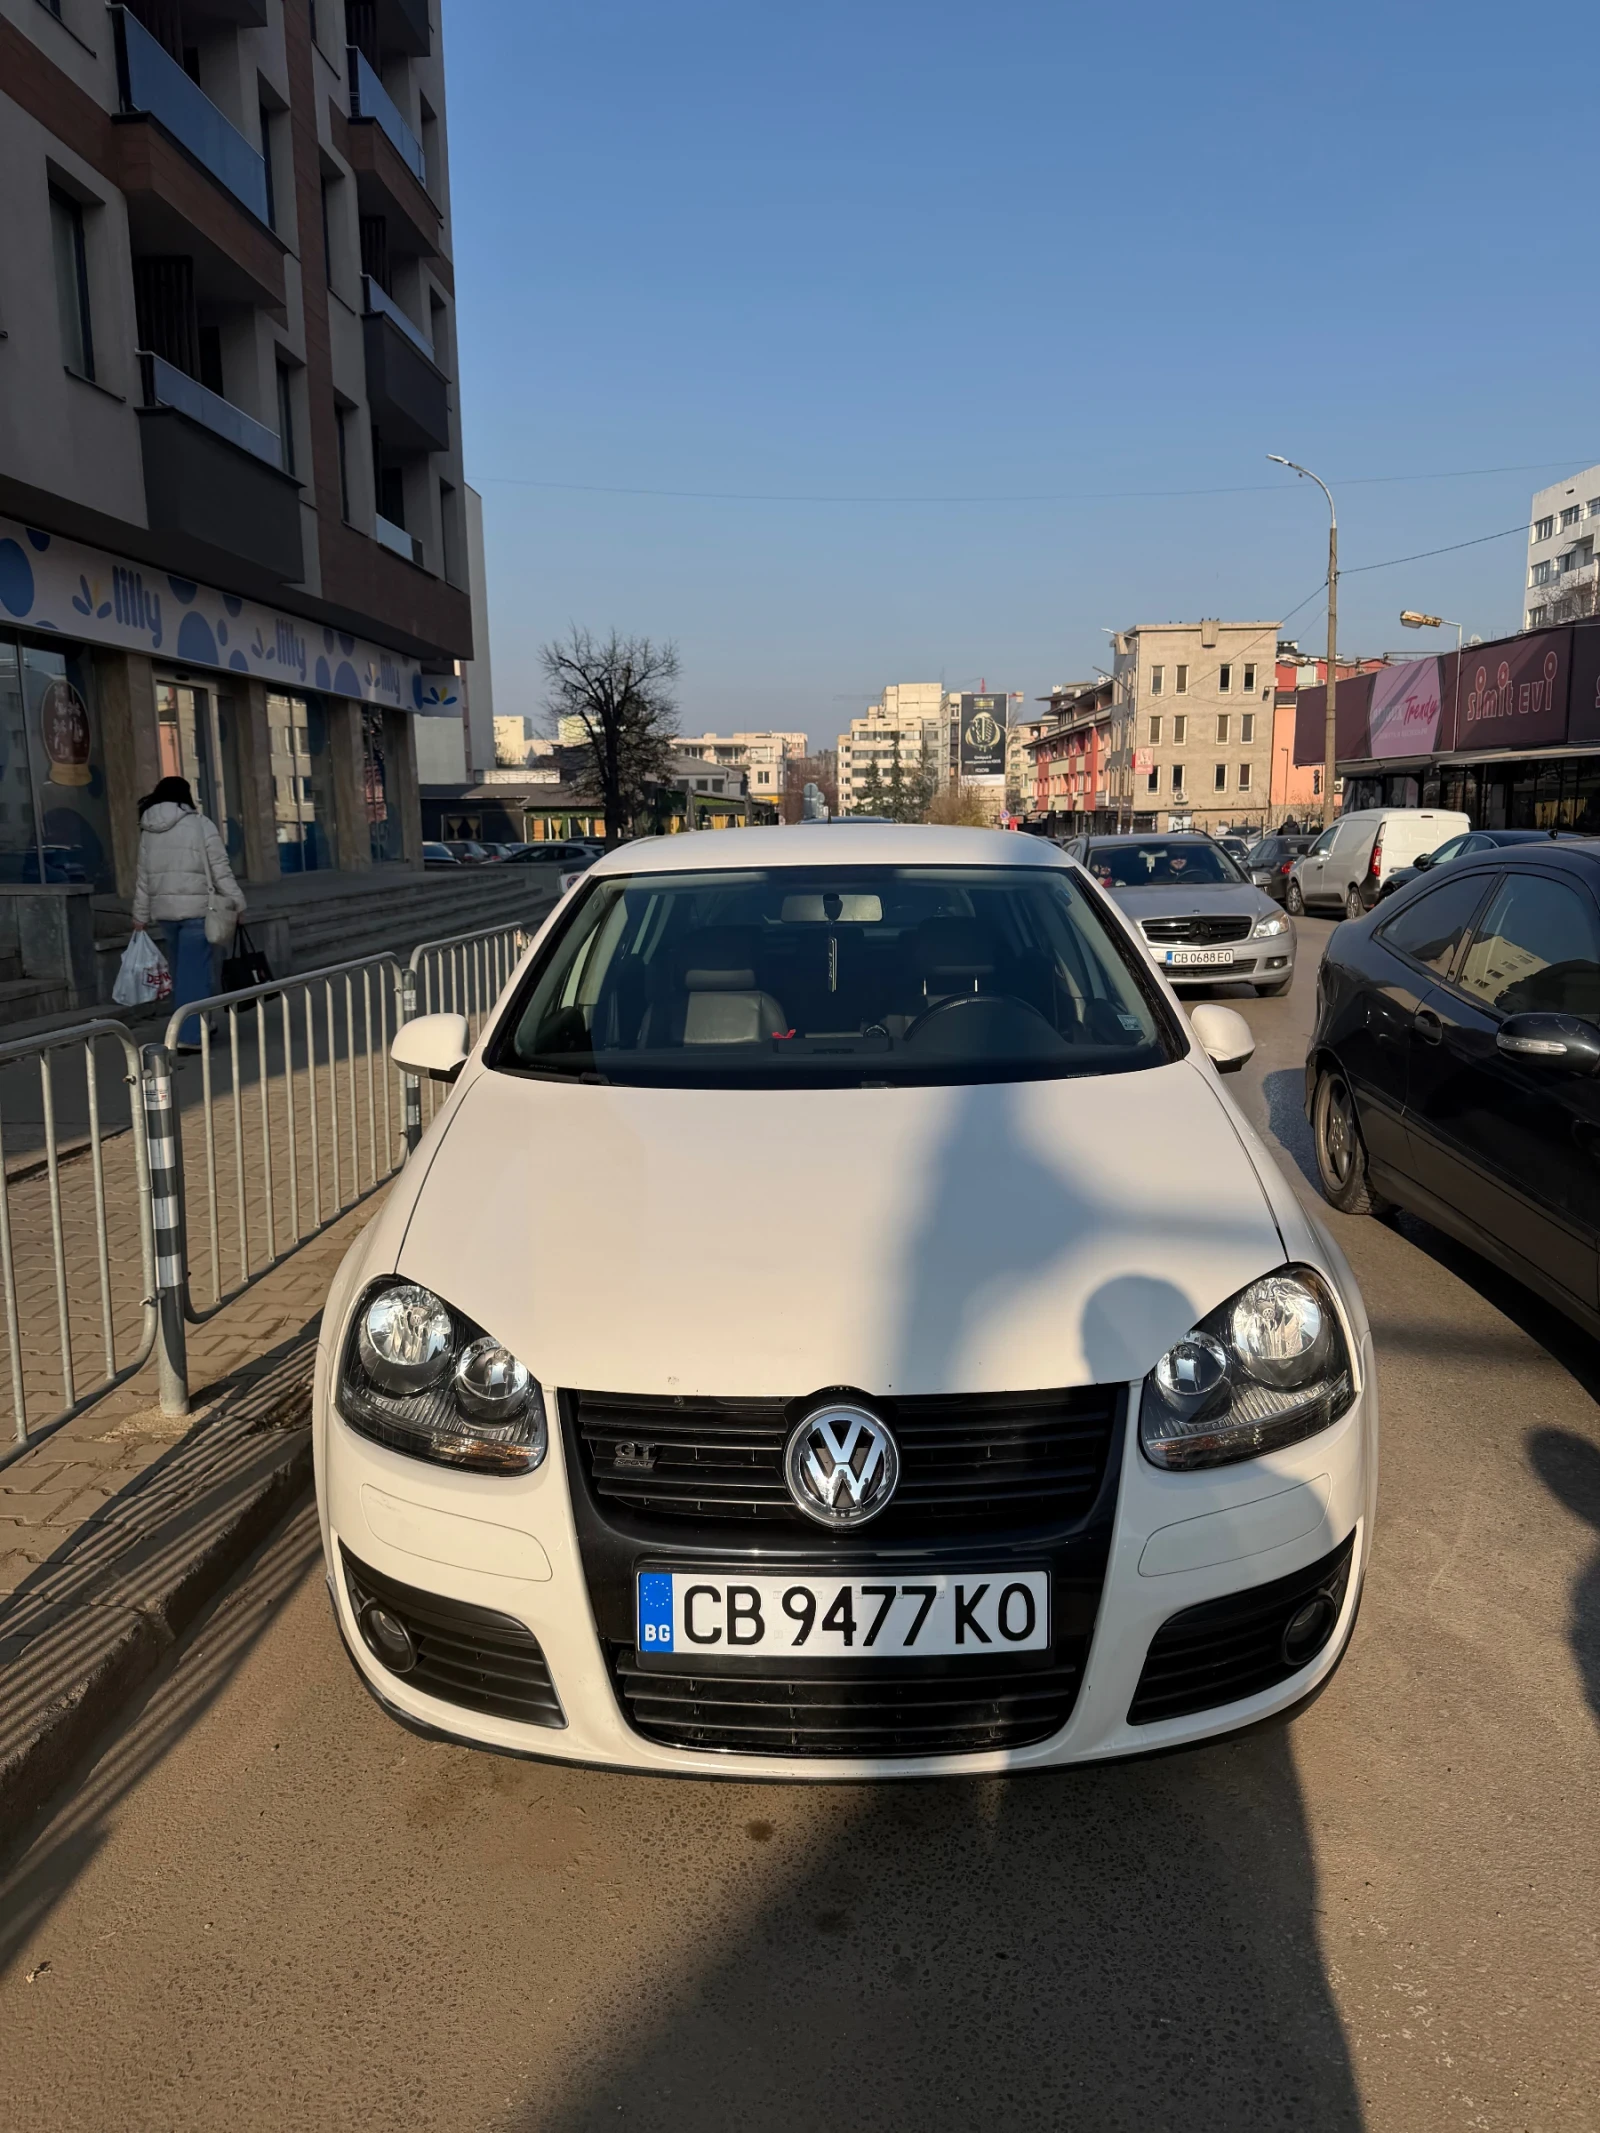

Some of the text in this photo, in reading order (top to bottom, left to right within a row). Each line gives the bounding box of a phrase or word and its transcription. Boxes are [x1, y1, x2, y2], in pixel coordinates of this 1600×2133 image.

[112, 564, 163, 649] lilly
[275, 618, 307, 683] lilly
[379, 653, 401, 705] lilly
[1467, 661, 1513, 721] simit
[1402, 693, 1437, 726] Trendy
[1174, 953, 1188, 964] CB
[1190, 952, 1216, 963] 0688
[614, 1440, 655, 1459] GT
[644, 1623, 671, 1642] BG
[684, 1581, 1037, 1647] CB 9477 KO
